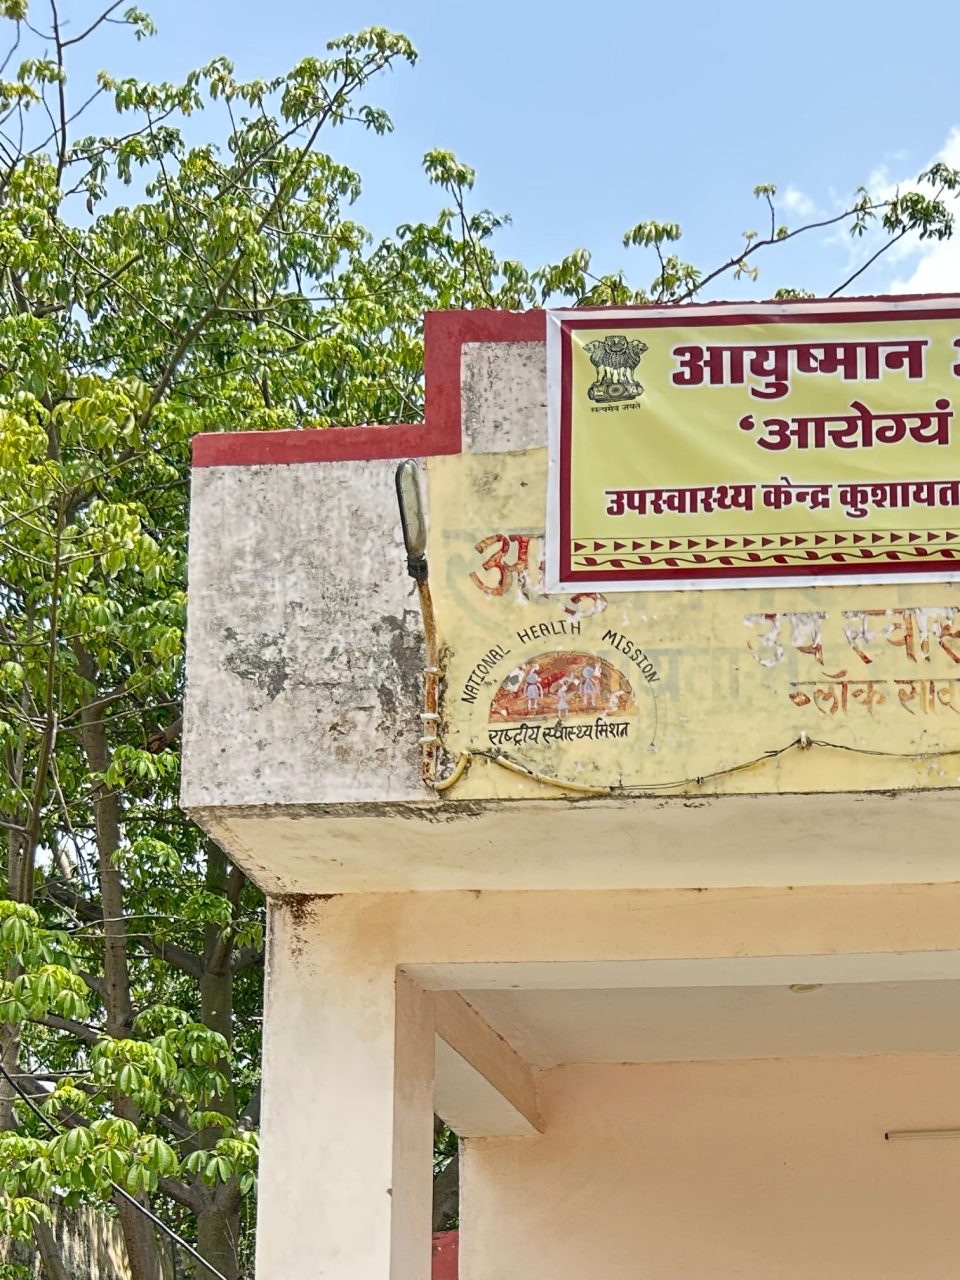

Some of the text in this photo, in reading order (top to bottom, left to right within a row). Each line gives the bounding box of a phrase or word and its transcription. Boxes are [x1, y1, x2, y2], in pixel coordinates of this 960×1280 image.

[672, 340, 928, 399] आयुष्मान
[606, 484, 755, 516] उपस्वास्थ्य
[762, 476, 832, 511] केन्द्र
[461, 620, 660, 704] NATIONAL HEALTH MISSION
[488, 718, 630, 746] राष्ट्रीय स्वास्थ्य मिशन
